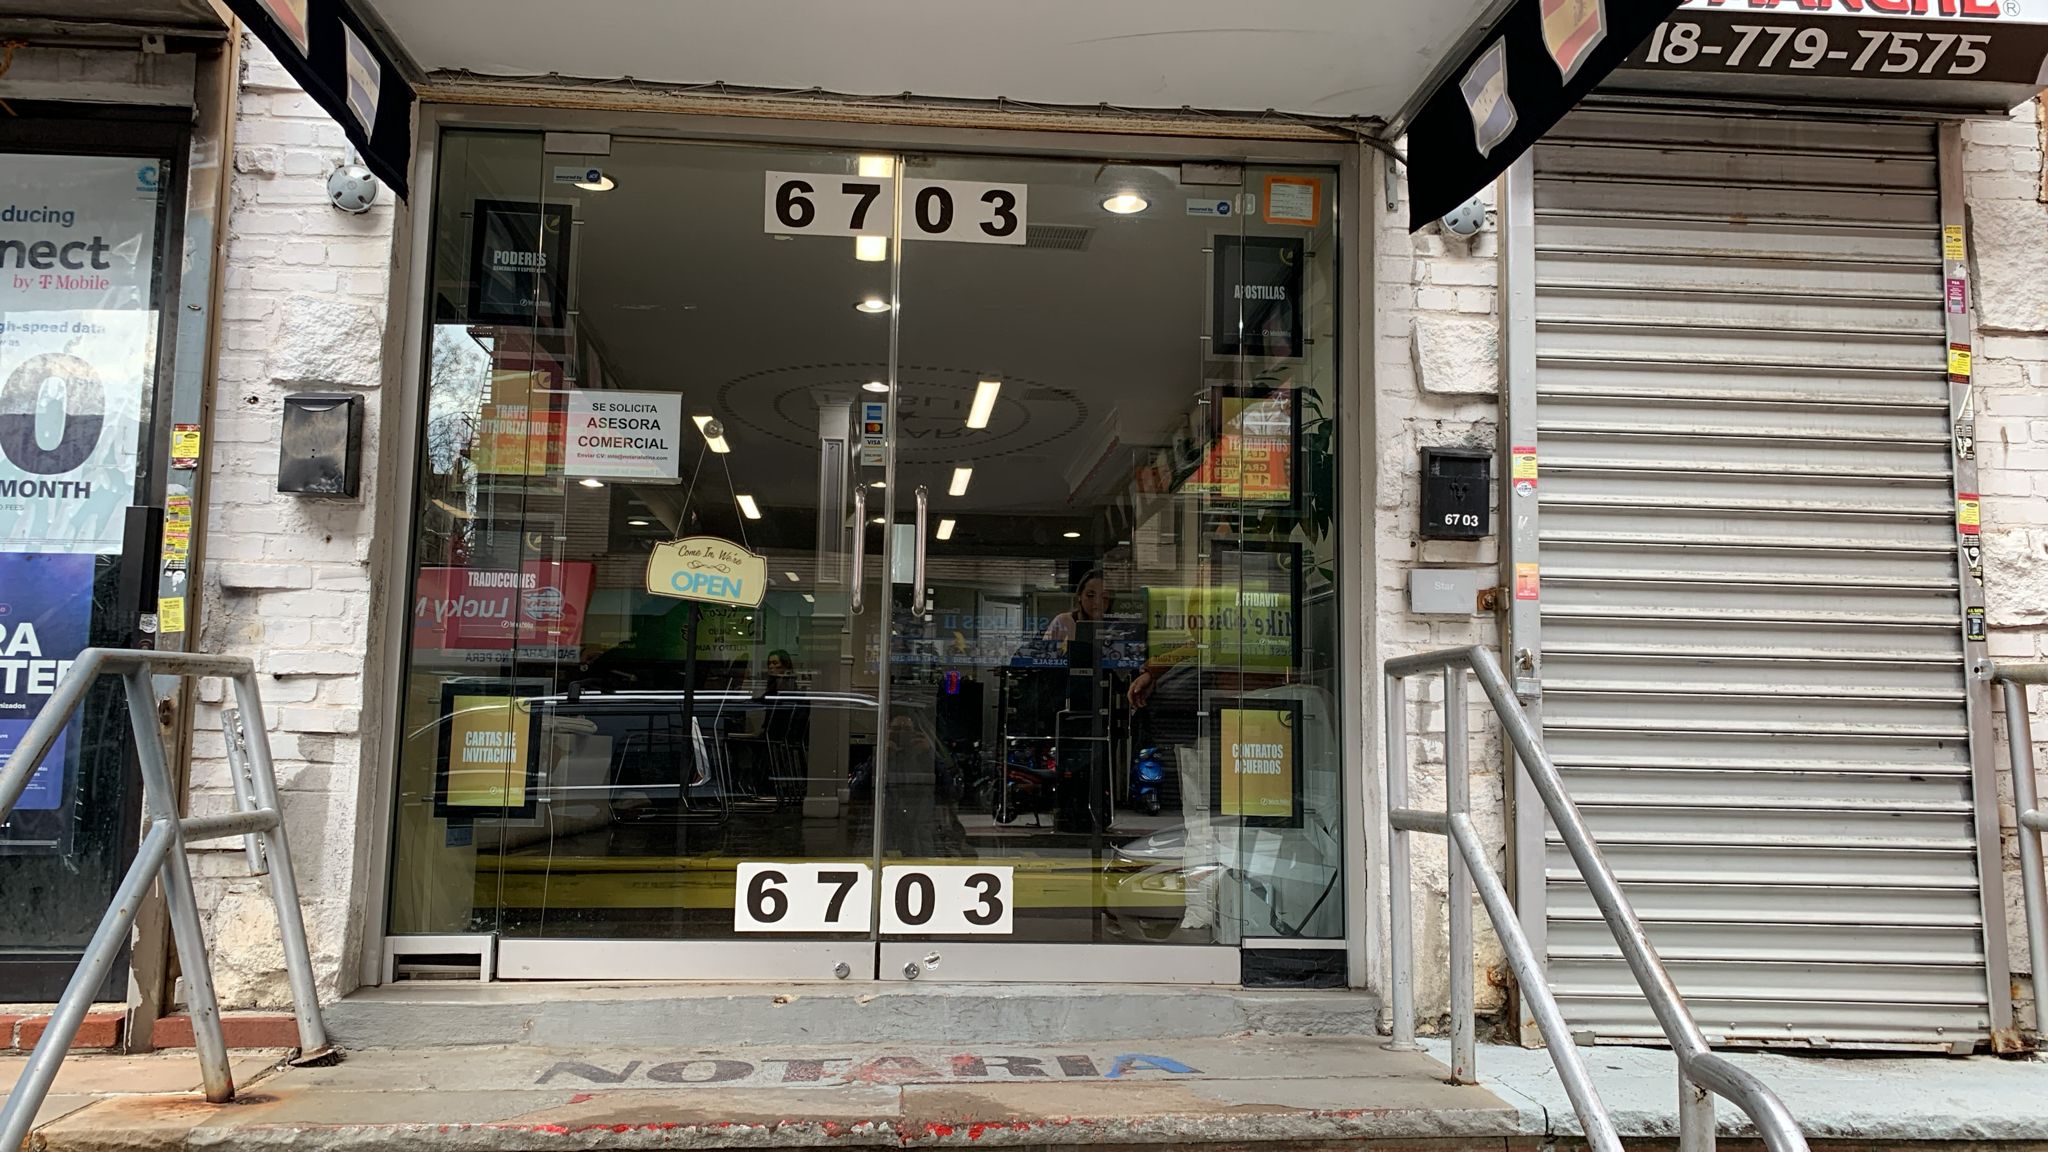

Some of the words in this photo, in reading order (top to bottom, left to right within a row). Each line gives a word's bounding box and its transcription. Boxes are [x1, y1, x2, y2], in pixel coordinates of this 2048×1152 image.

[1644, 22, 1992, 75] 18-779-7575
[1, 205, 75, 228] ducing
[0, 236, 111, 270] nect
[13, 274, 34, 293] by
[592, 402, 606, 412] SE
[609, 403, 658, 413] SOLICITA
[586, 417, 661, 431] ASESORA
[578, 436, 669, 450] COMERCIAL
[0, 479, 91, 499] MONTH
[678, 544, 702, 557] Come
[671, 570, 743, 599] OPEN
[1235, 591, 1280, 608] AFFIDAVIT
[0, 622, 42, 657] A
[465, 731, 503, 747] CARTAS
[1234, 760, 1281, 775] ACUERDOS
[533, 1053, 1206, 1085] NOTARIA
